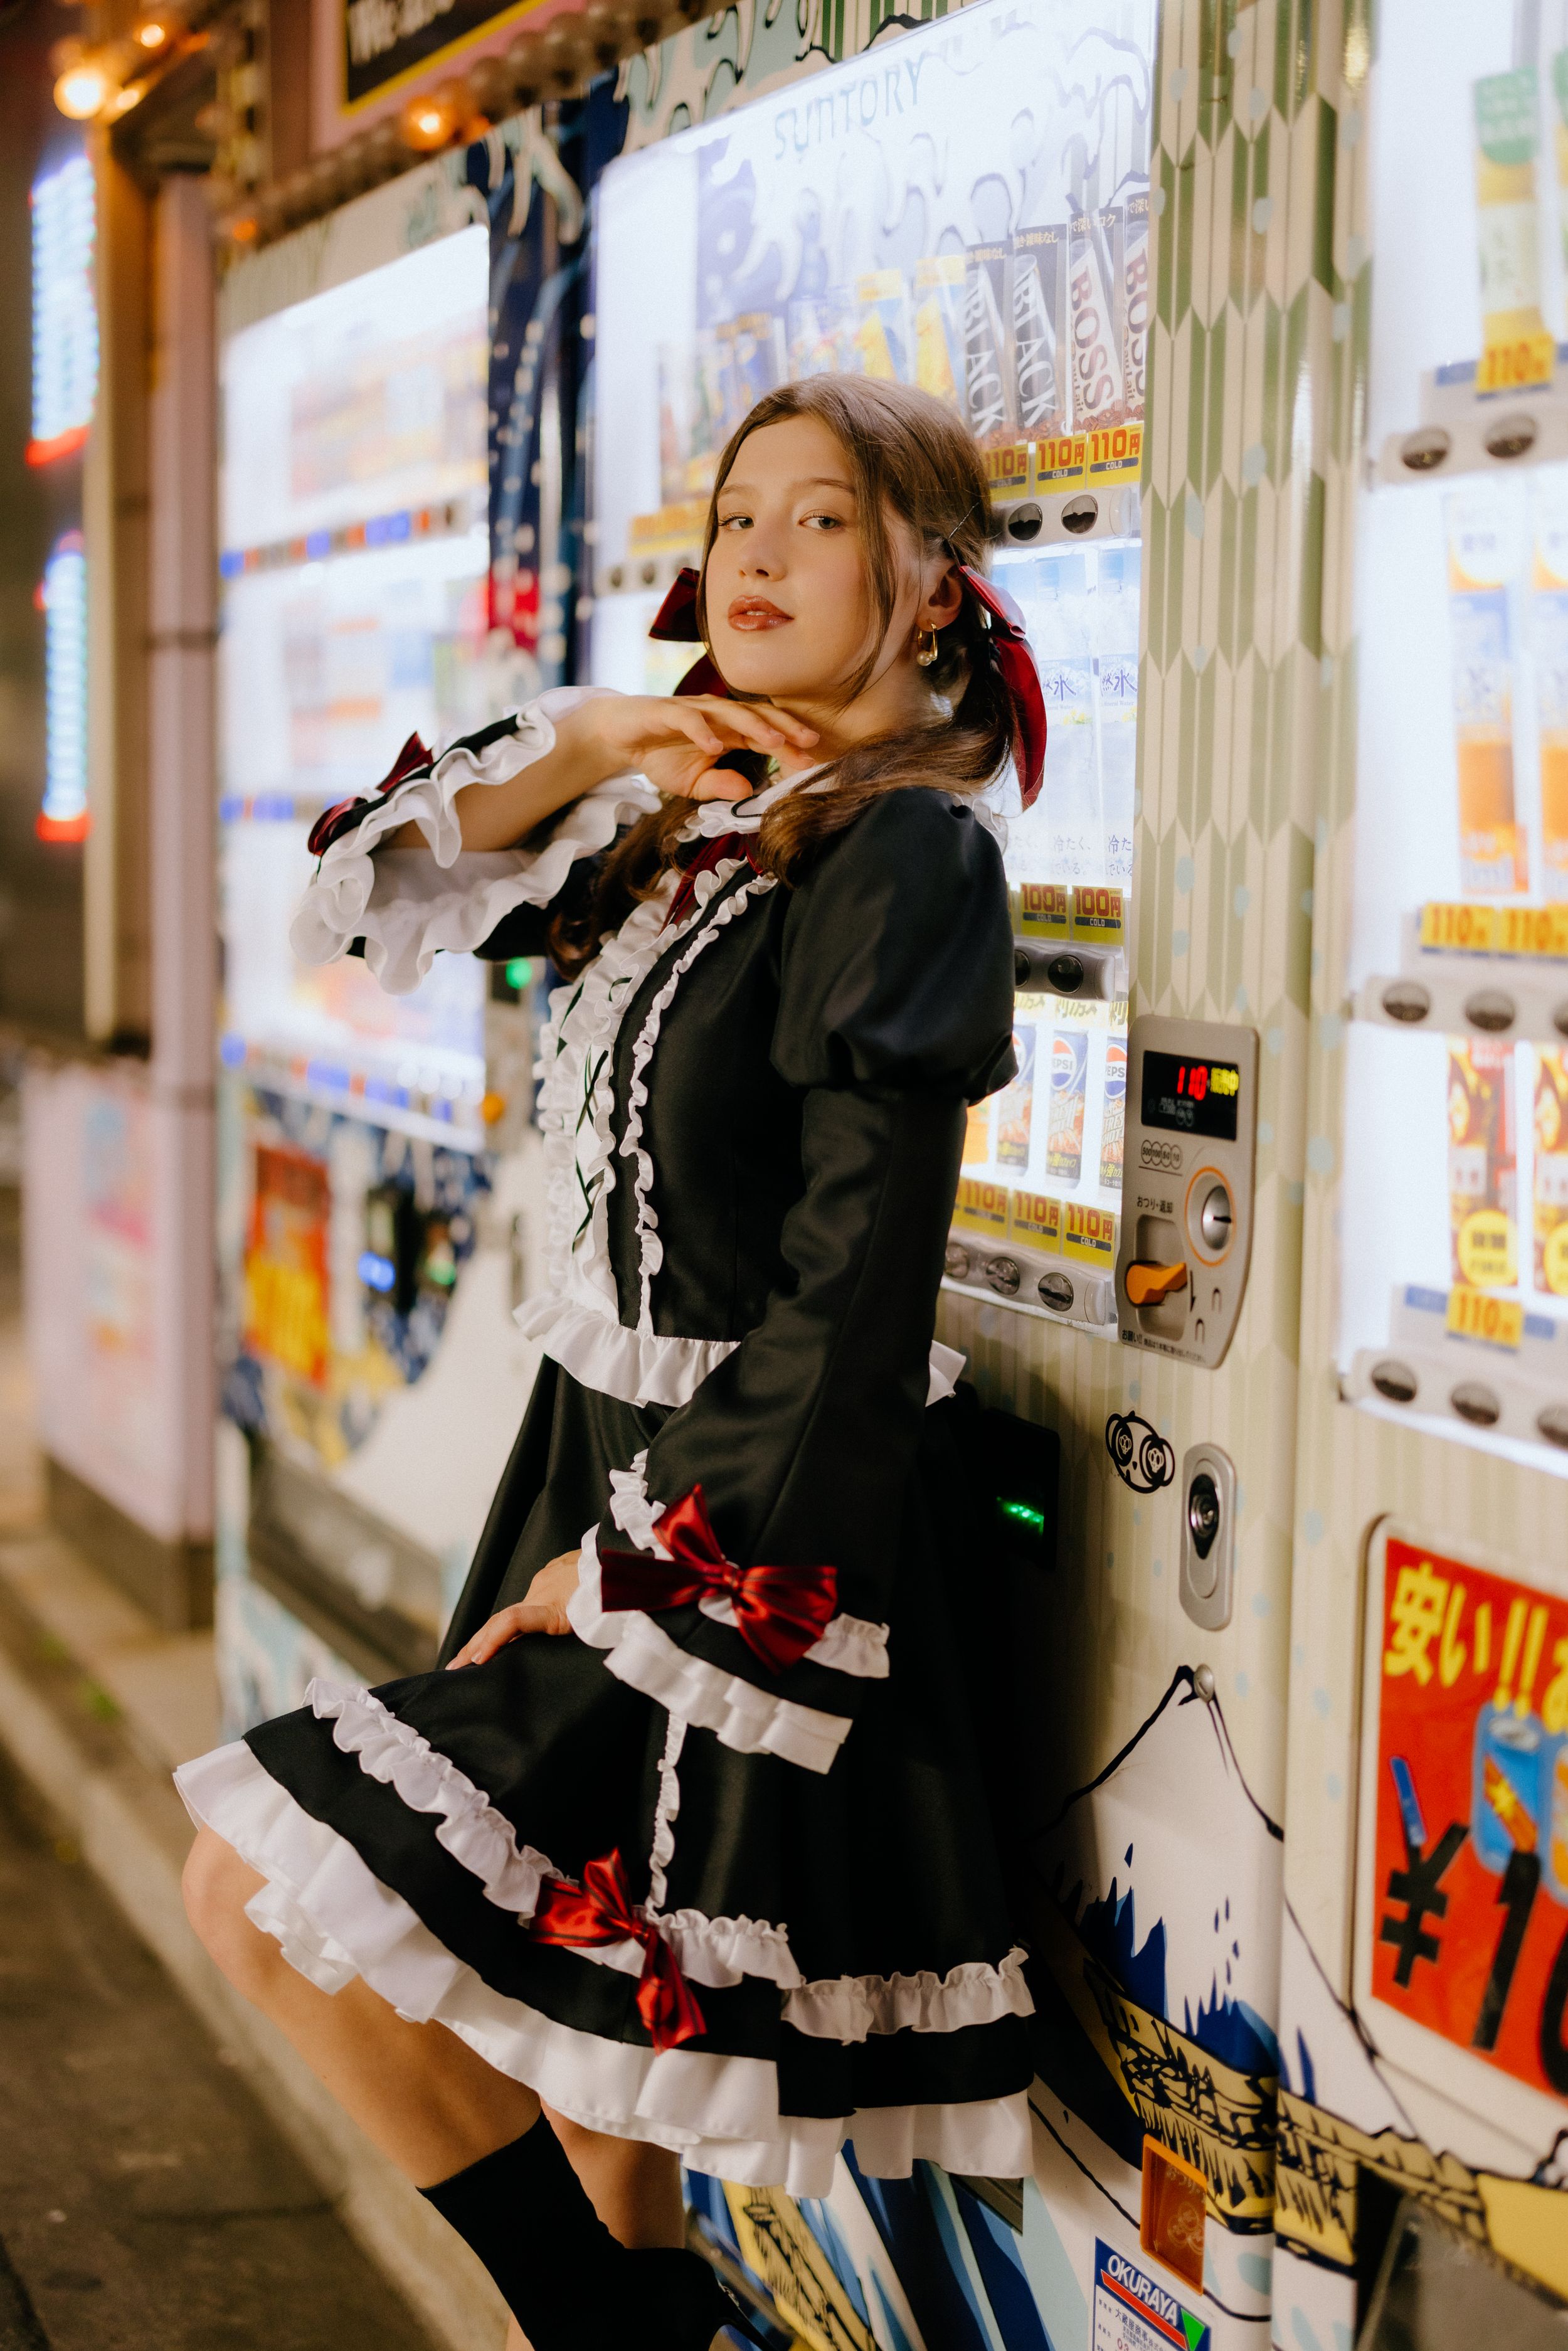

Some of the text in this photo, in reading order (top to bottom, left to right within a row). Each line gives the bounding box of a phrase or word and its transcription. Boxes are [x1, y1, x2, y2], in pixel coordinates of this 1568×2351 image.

[775, 51, 925, 161] SUNTORY
[1014, 271, 1059, 430] BLACK
[1071, 265, 1115, 410] BOSS
[1038, 438, 1084, 470] 110円
[1092, 429, 1140, 462] 110円
[1052, 469, 1068, 479] COLD
[1106, 460, 1122, 470] COLD
[1022, 884, 1066, 913] 100円
[1074, 887, 1121, 917] 100円
[1036, 914, 1052, 922] COLD
[1089, 918, 1105, 927] COLD
[1017, 1192, 1059, 1226] 110円
[1068, 1204, 1113, 1241] 110円
[1081, 1236, 1096, 1248] COLD
[1108, 2254, 1178, 2327] OKURAYA
